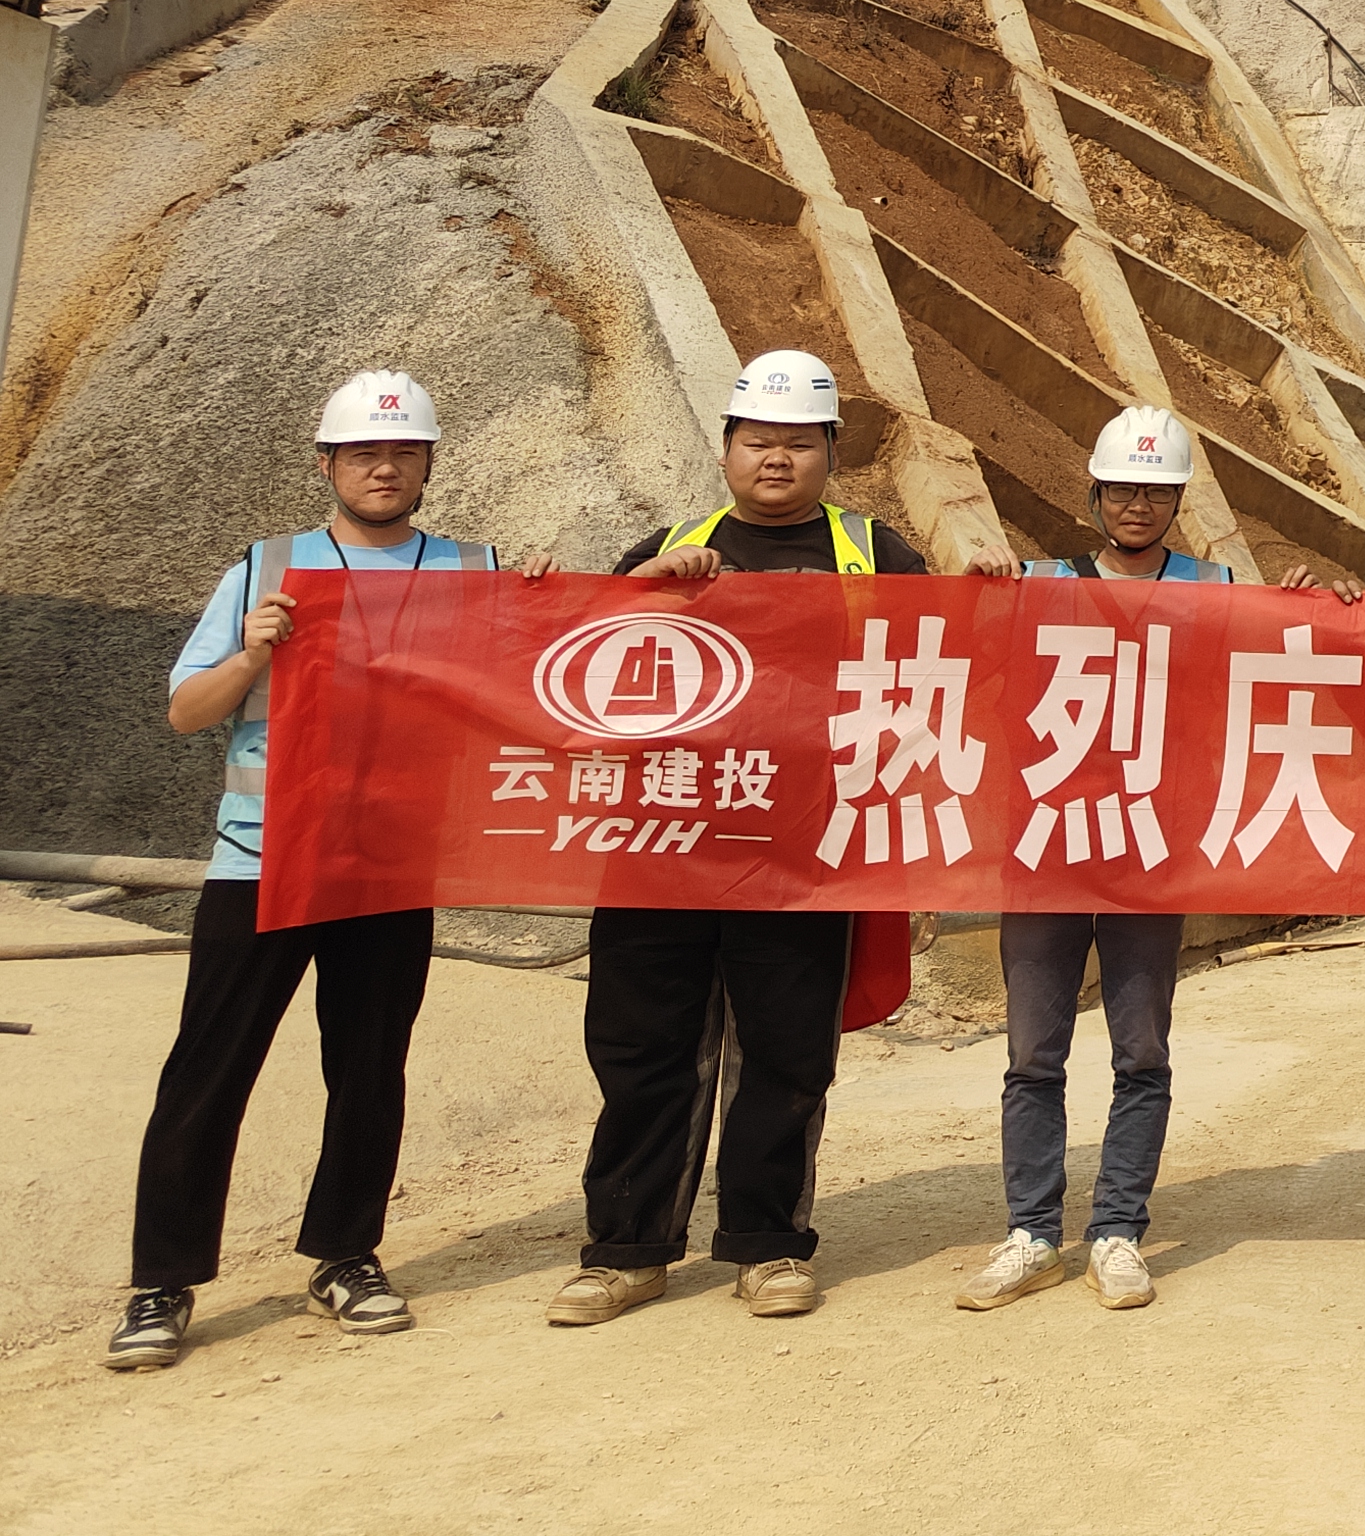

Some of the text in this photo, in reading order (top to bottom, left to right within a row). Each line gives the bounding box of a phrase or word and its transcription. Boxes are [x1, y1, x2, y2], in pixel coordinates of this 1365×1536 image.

[489, 746, 779, 812] 云南建投
[549, 815, 709, 854] YCIH
